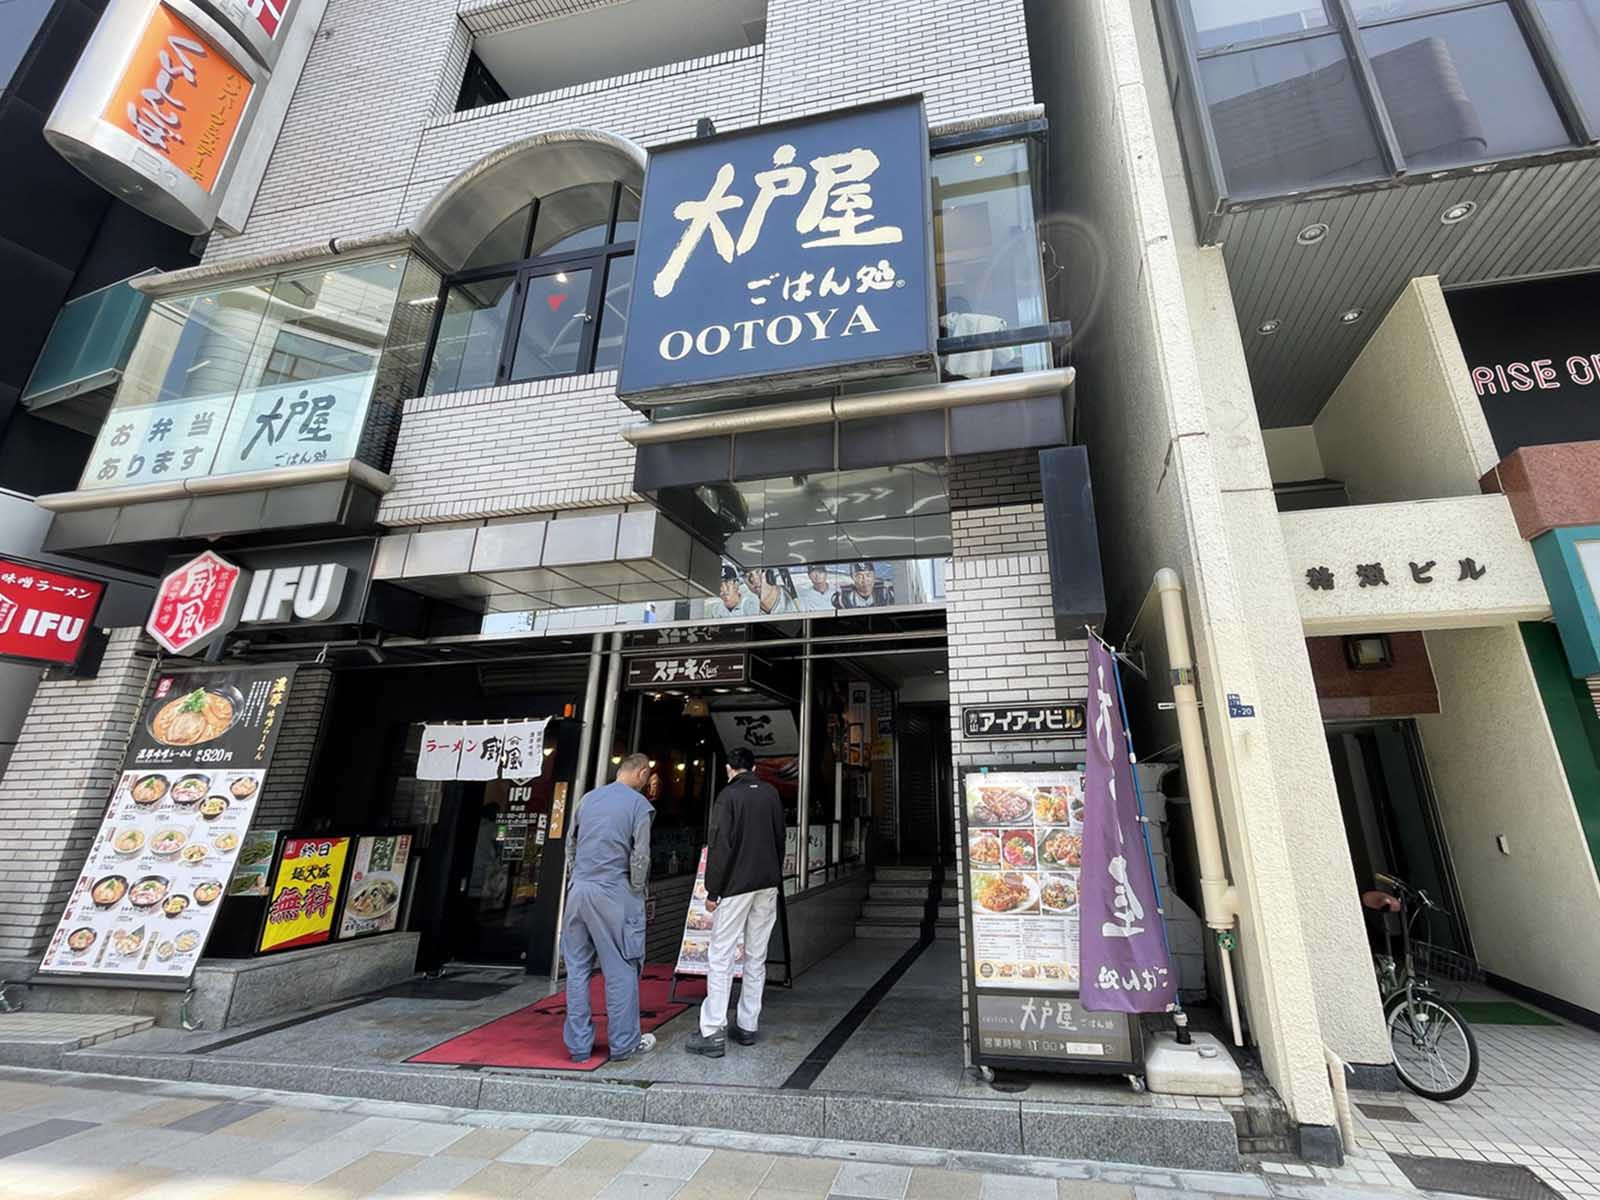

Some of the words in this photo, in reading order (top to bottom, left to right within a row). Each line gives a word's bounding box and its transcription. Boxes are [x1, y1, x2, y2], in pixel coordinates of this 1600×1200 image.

[653, 144, 903, 298] 大戸屋
[747, 259, 896, 305] ごはん処
[658, 304, 880, 361] OOTOYA
[1472, 359, 1560, 396] RISE
[110, 411, 214, 448] お弁当
[241, 389, 336, 461] 大戸屋
[97, 446, 204, 481] あります
[1, 572, 93, 600] 味噌ラーメン
[240, 563, 342, 621] IFU
[19, 608, 84, 642] IFU
[652, 658, 699, 681] ステーキ
[979, 708, 1082, 733] アイアイビル
[425, 739, 479, 753] ラーメン
[508, 787, 532, 802] IFU
[300, 842, 332, 858] 終日
[269, 881, 334, 925] 無料
[1020, 997, 1078, 1031] 大戸屋
